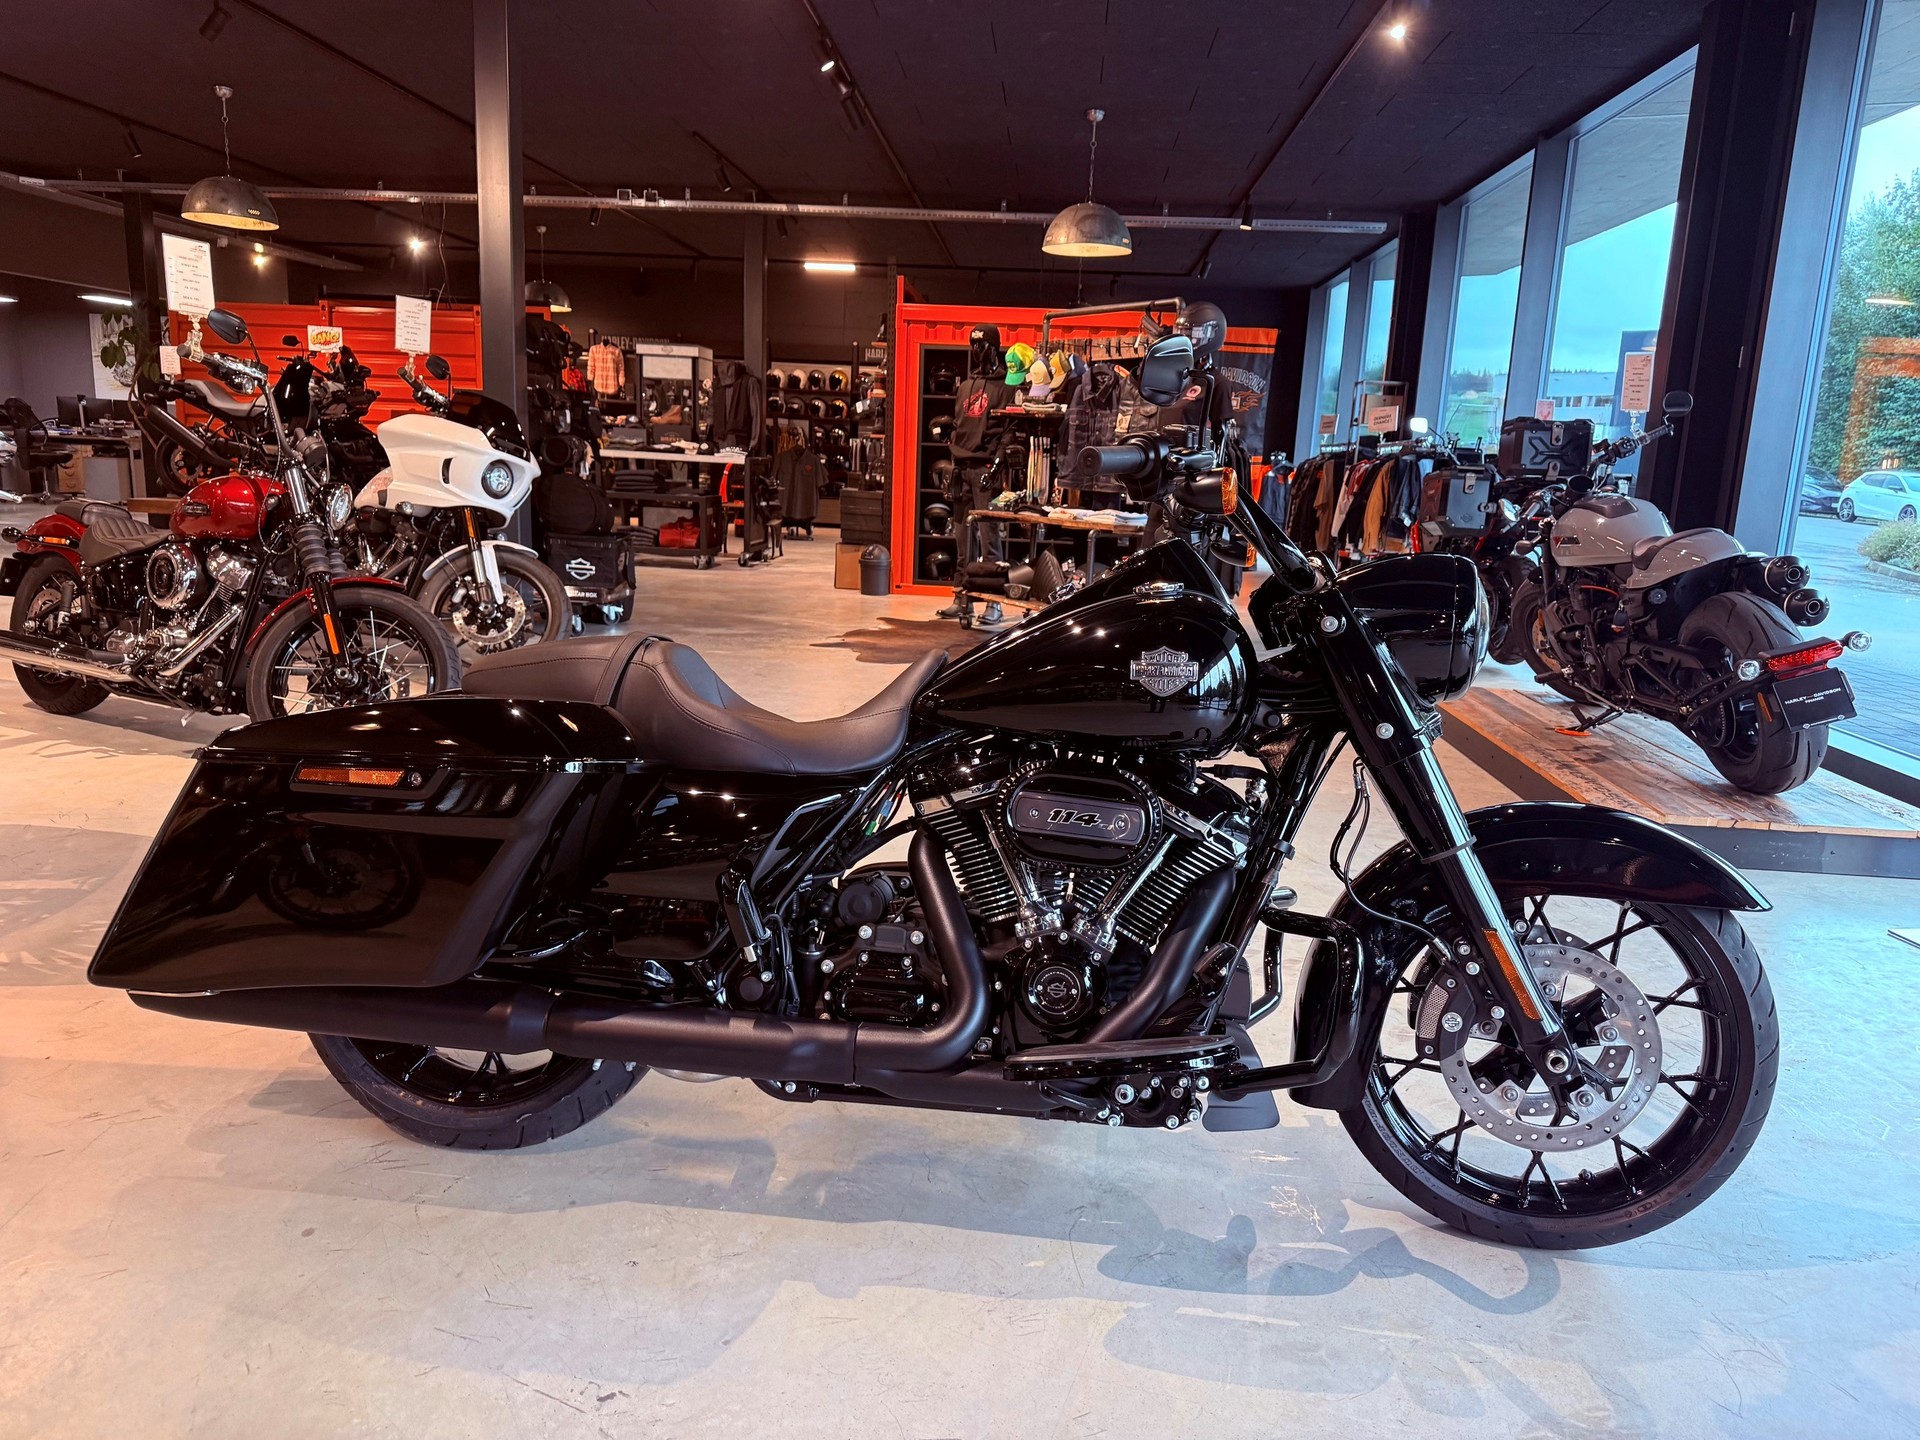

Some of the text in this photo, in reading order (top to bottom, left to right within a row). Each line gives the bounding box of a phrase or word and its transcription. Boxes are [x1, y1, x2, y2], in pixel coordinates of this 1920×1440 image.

[310, 331, 340, 345] BANG!
[1220, 366, 1266, 394] DAVIDSON
[585, 591, 598, 599] BOX
[1047, 808, 1102, 827] 114
